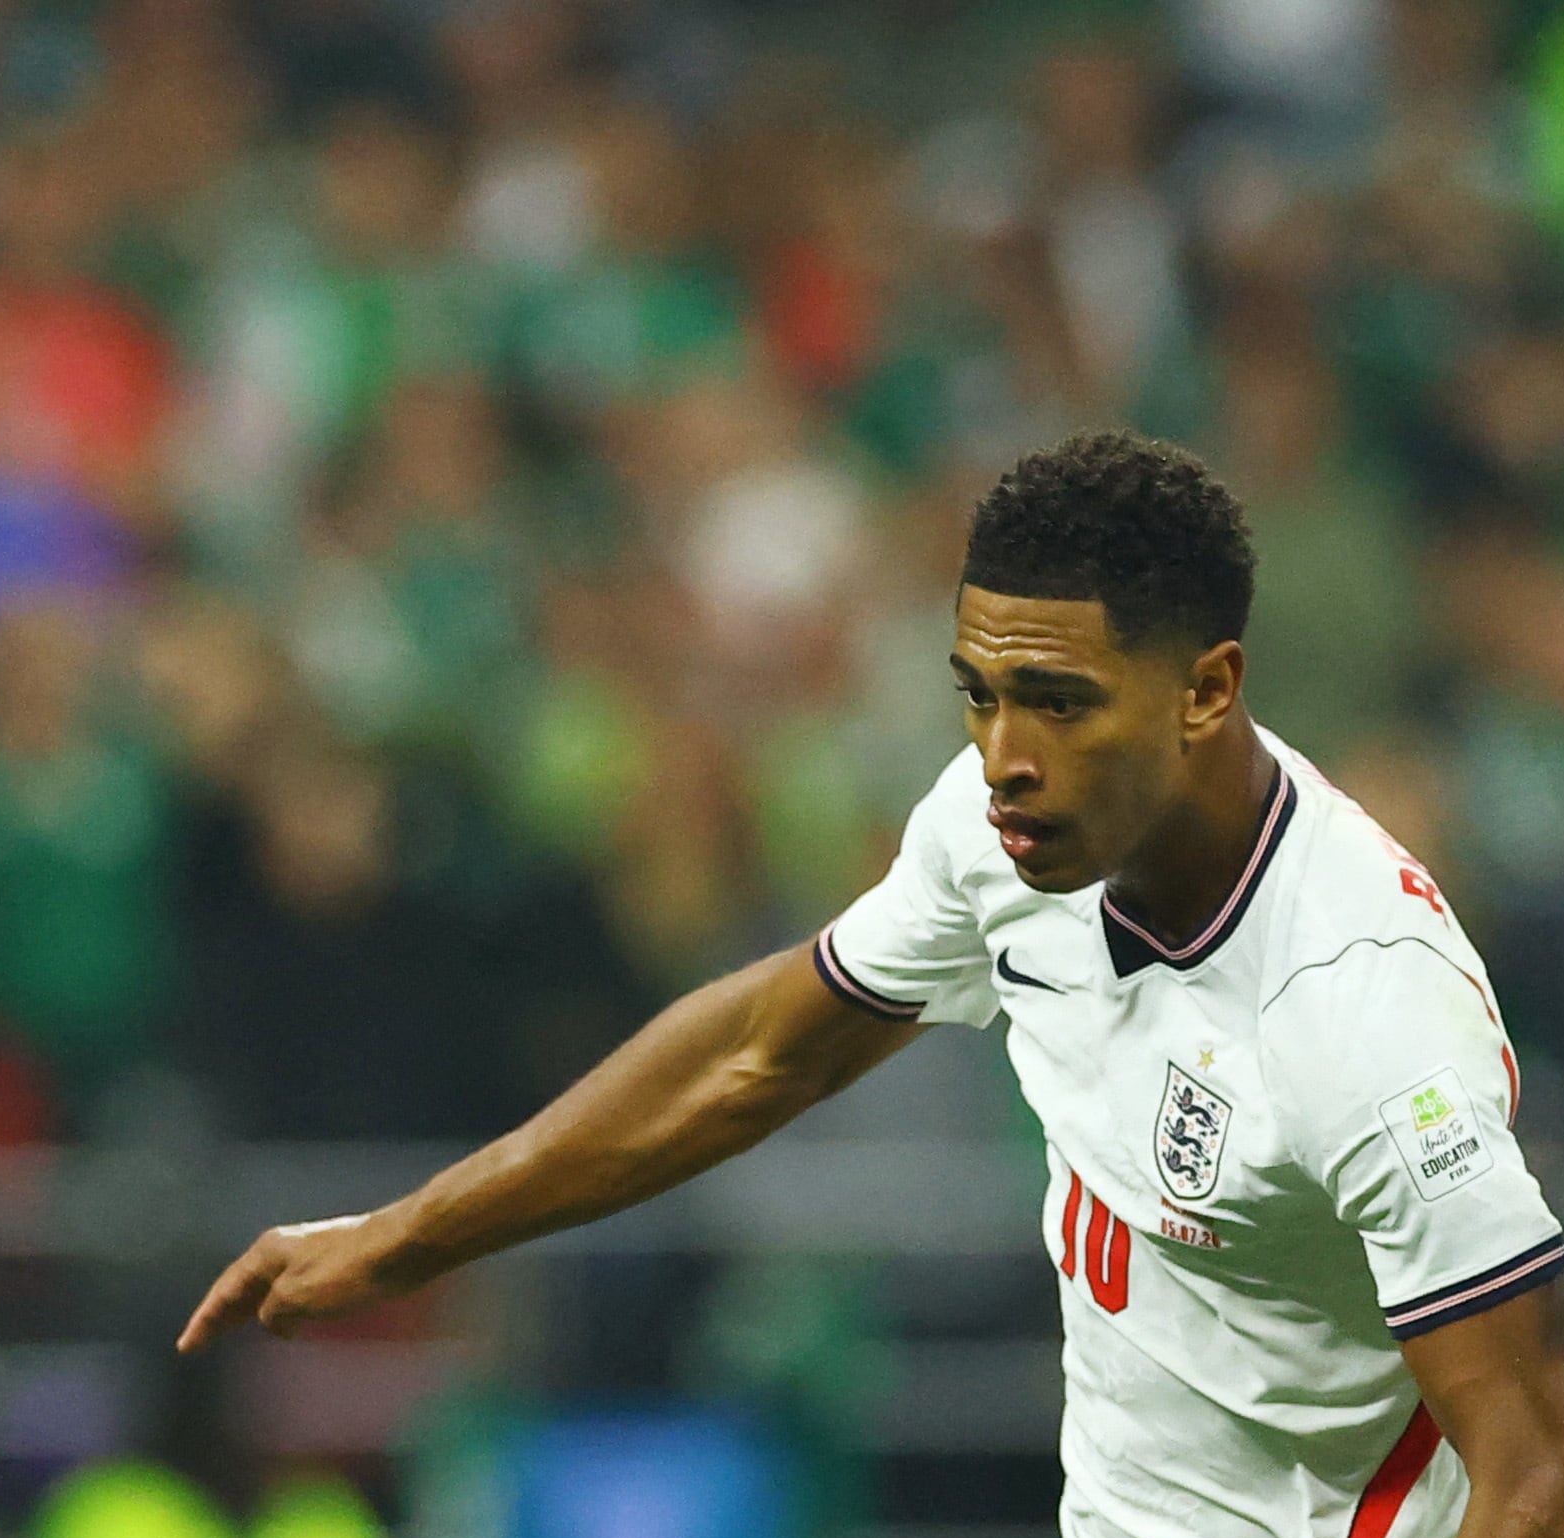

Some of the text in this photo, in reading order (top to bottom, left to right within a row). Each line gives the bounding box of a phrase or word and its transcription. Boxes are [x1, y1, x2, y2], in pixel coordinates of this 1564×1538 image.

[1420, 1136, 1480, 1179] EDUCATION
[1449, 1164, 1471, 1181] FIFA
[1060, 1167, 1132, 1315] 10
